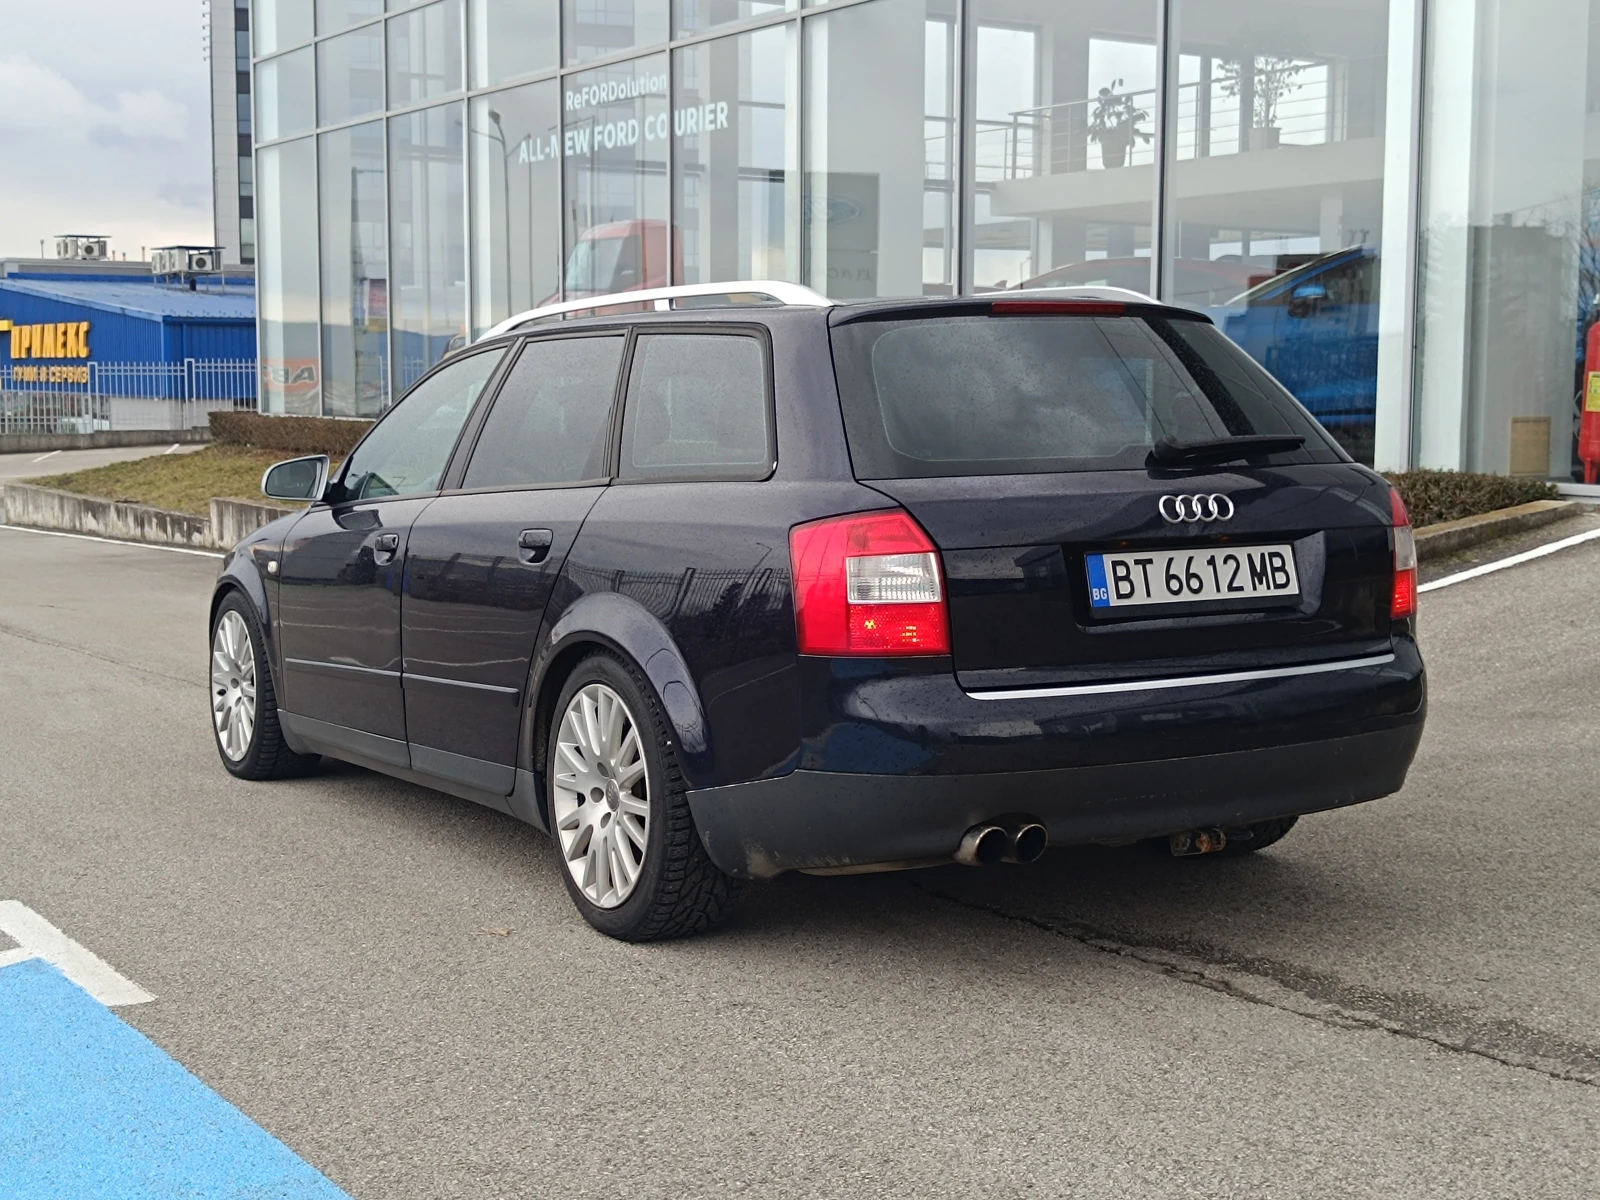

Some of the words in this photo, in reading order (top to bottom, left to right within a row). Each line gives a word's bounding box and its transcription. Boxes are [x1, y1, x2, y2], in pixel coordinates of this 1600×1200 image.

[566, 73, 667, 111] ReFORDolution
[594, 119, 639, 151] FORD
[644, 101, 728, 141] COURIER
[11, 321, 90, 359] ПРИМЕКС
[49, 366, 88, 384] СЕРВИЗ
[1093, 588, 1108, 600] BG
